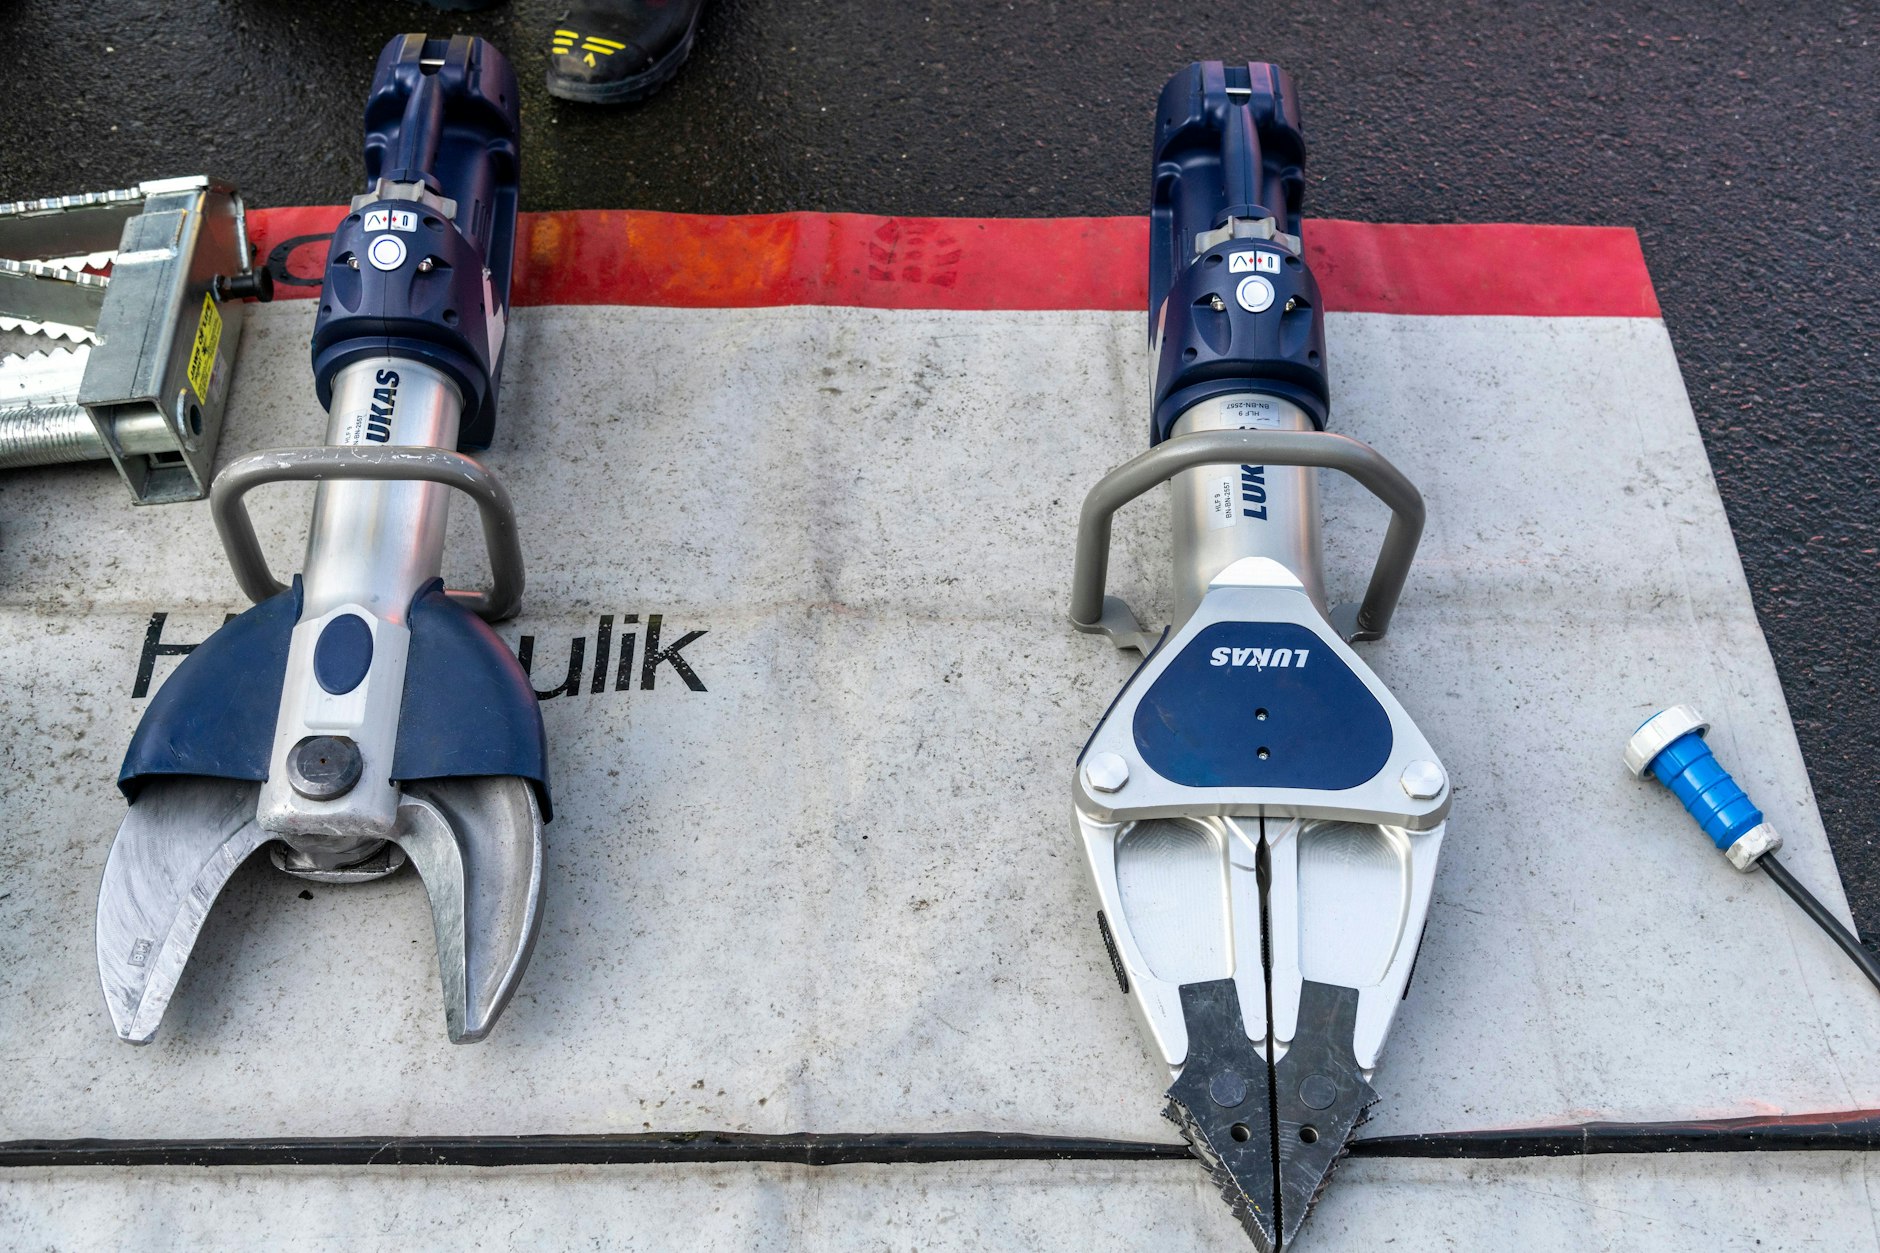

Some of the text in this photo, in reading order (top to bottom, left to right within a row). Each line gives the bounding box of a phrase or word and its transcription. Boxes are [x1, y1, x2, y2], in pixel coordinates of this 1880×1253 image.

[366, 369, 400, 446] UKAS
[1226, 402, 1270, 410] BN-BN-2557
[353, 415, 363, 446] N-BN-2557
[1224, 482, 1232, 519] BN-BN-2557
[1209, 646, 1310, 668] LUKAS
